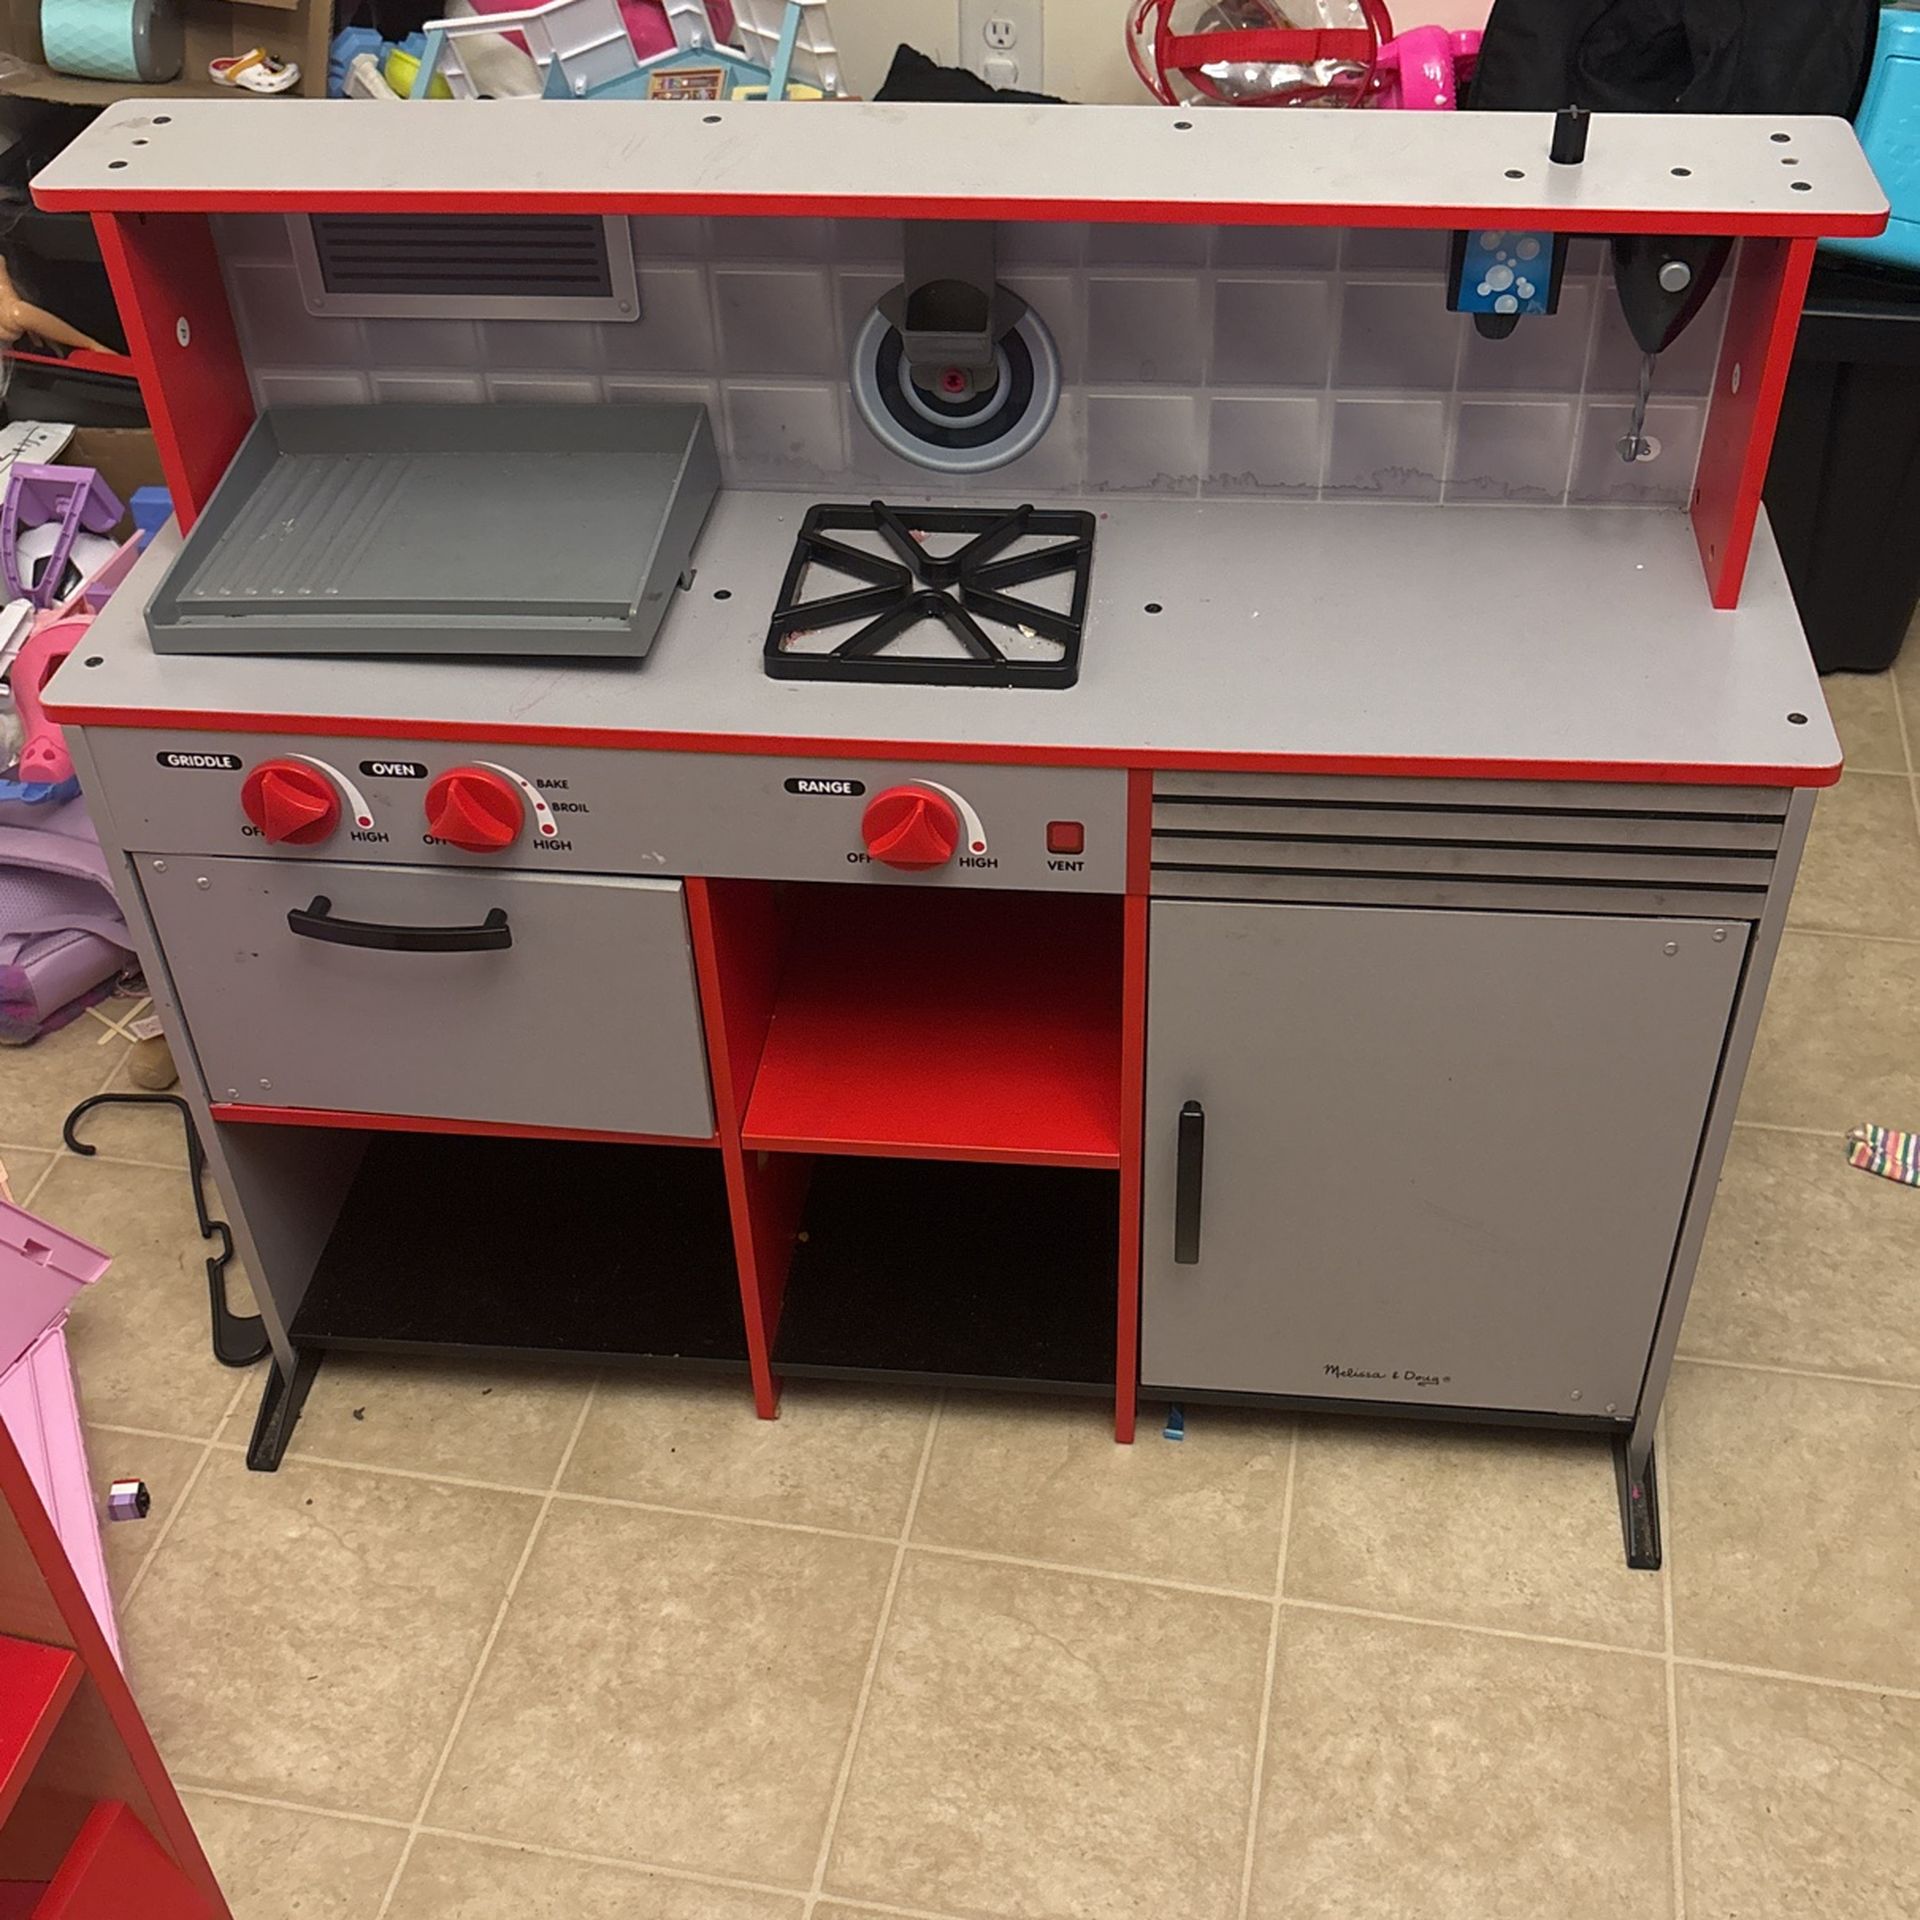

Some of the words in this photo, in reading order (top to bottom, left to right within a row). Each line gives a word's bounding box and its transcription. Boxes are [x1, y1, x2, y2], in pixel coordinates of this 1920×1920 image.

[167, 753, 232, 769] GRIDDLE
[372, 762, 415, 777] OVEN
[536, 778, 569, 790] BAKE
[798, 780, 852, 794] RANGE
[552, 802, 590, 814] BROIL
[351, 830, 389, 843] HIGH
[533, 840, 573, 853] HIGH
[959, 857, 999, 870] HIGH
[1047, 860, 1085, 873] VENT
[1324, 1364, 1386, 1379] Melissa
[1404, 1370, 1440, 1387] Doug
